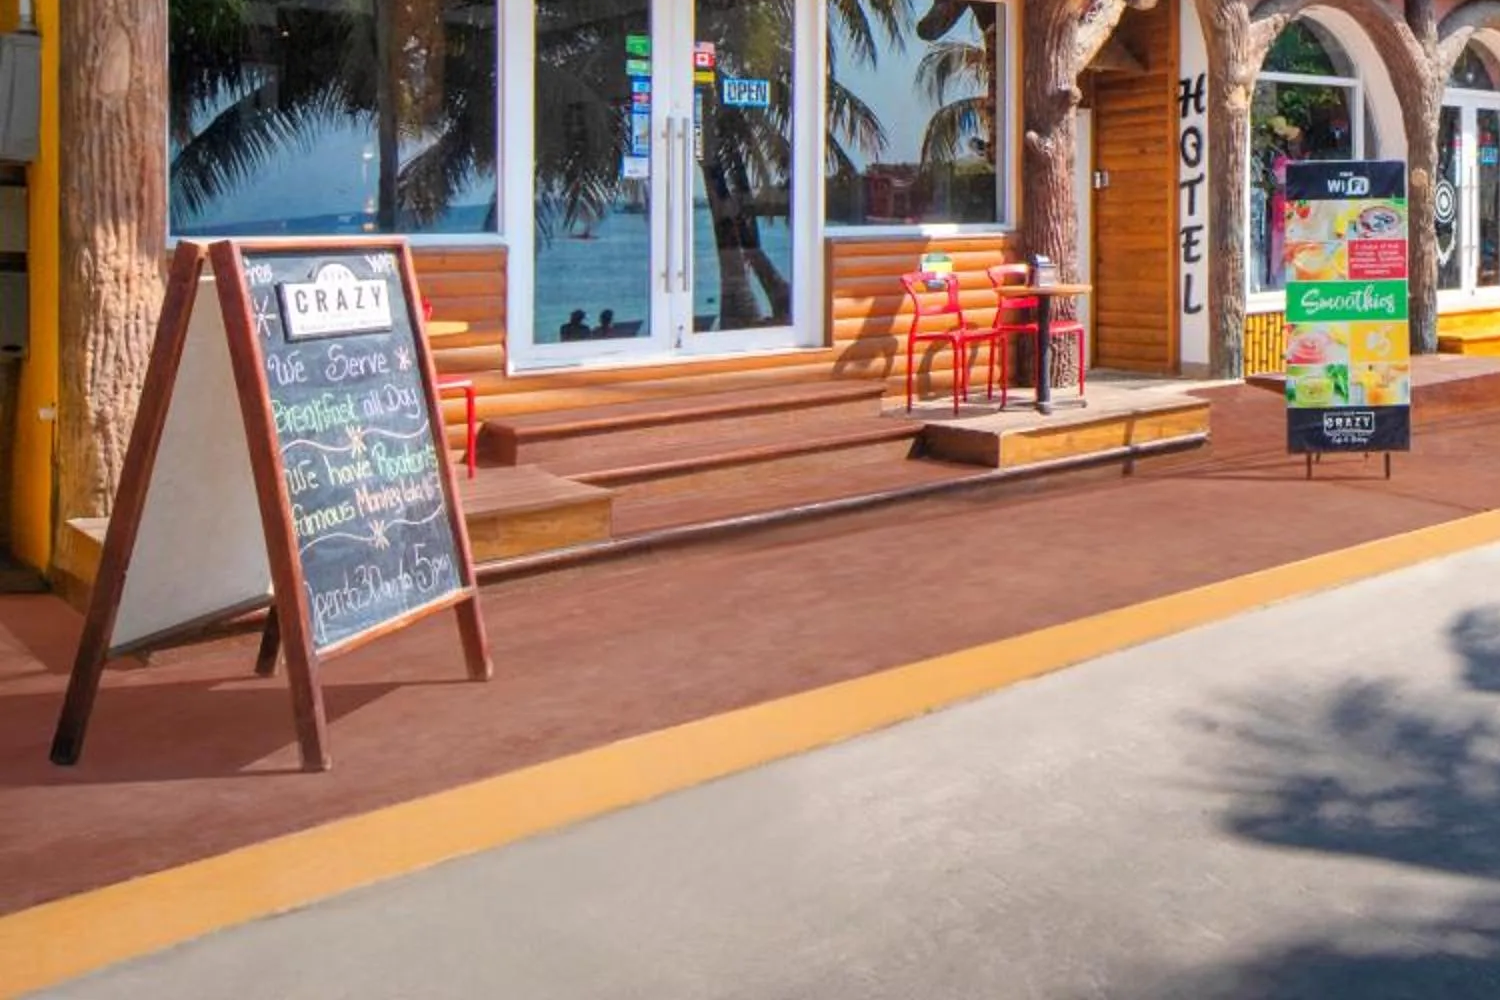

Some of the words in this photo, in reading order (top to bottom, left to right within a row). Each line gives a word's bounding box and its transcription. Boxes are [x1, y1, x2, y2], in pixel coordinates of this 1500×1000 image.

[727, 82, 767, 102] OPEN
[1177, 73, 1205, 314] HOTEL
[294, 286, 381, 314] CRAZY
[1301, 284, 1396, 315] Smoothies
[267, 350, 307, 385] We
[325, 344, 390, 381] Serve
[383, 384, 421, 419] Day
[284, 459, 319, 496] We
[323, 454, 373, 486] have
